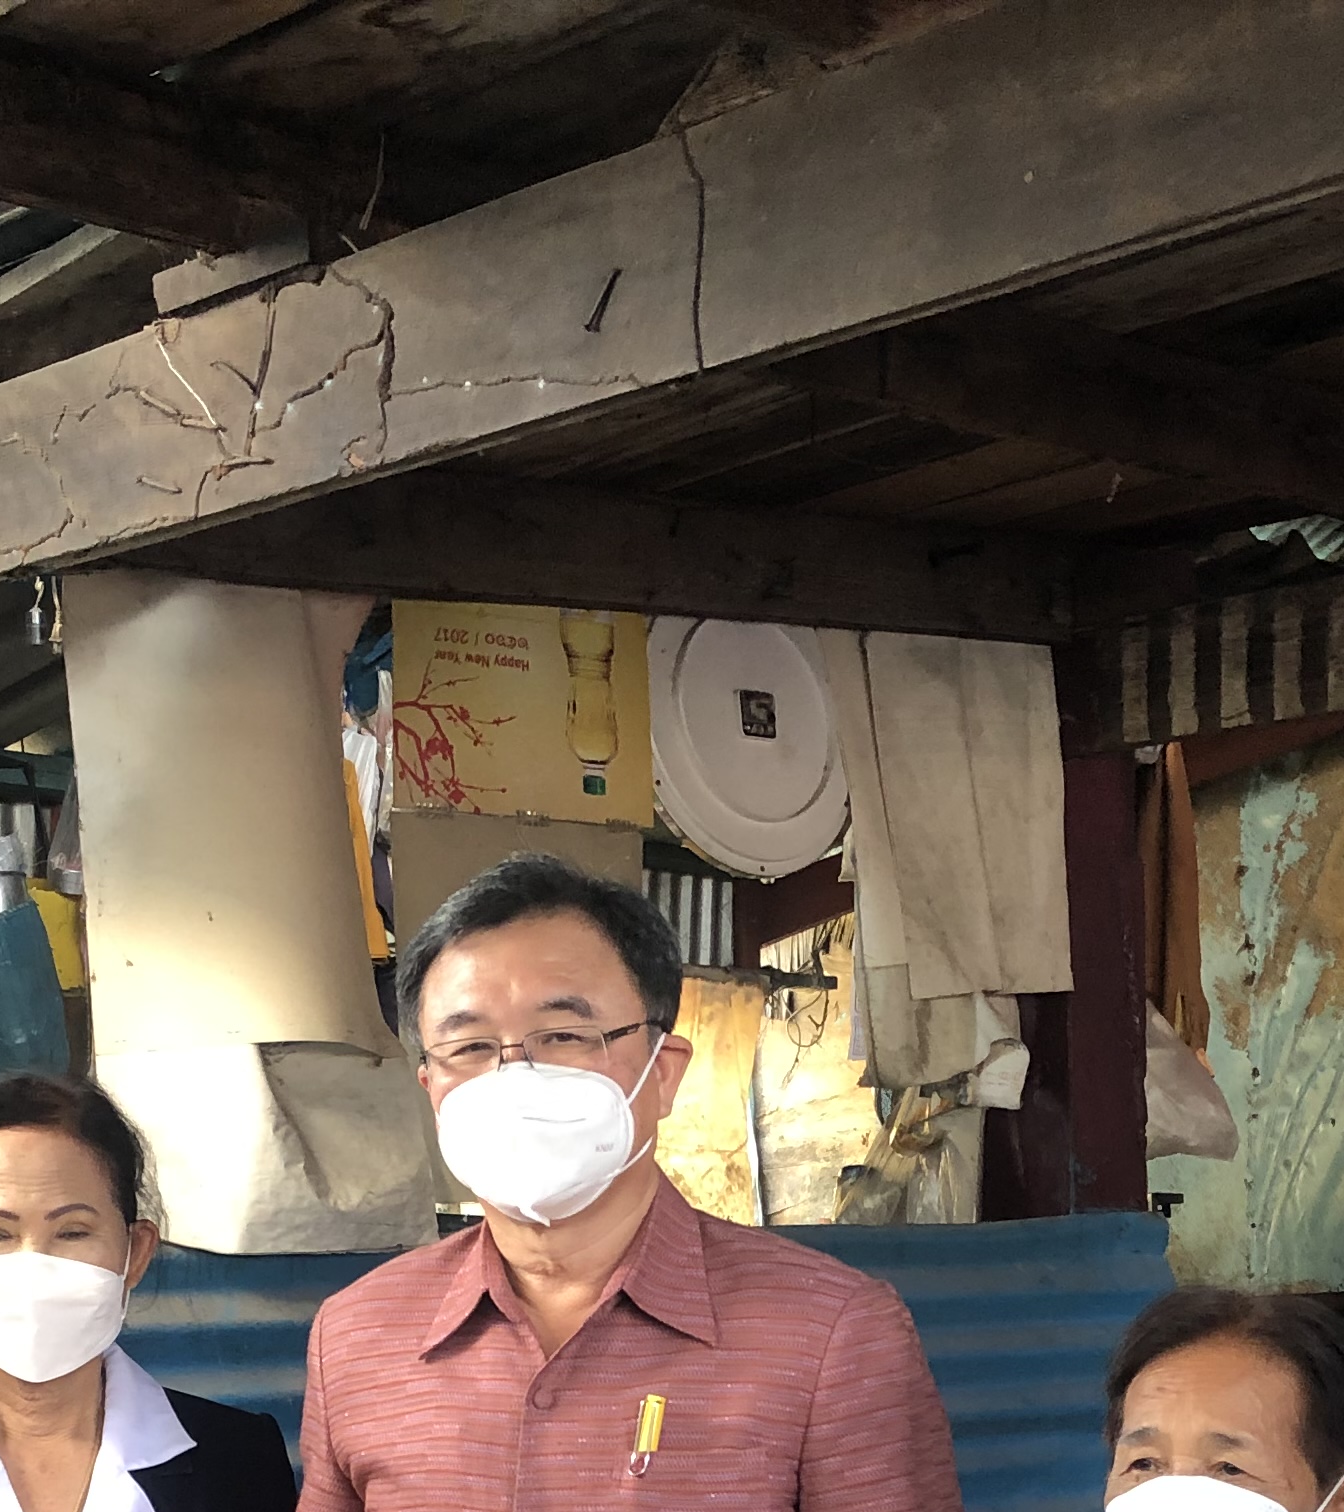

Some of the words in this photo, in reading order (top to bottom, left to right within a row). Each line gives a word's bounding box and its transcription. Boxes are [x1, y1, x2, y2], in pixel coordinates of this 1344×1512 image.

[434, 627, 468, 644] 2017
[434, 649, 461, 665] Year
[465, 652, 490, 668] New
[494, 652, 529, 672] Happy
